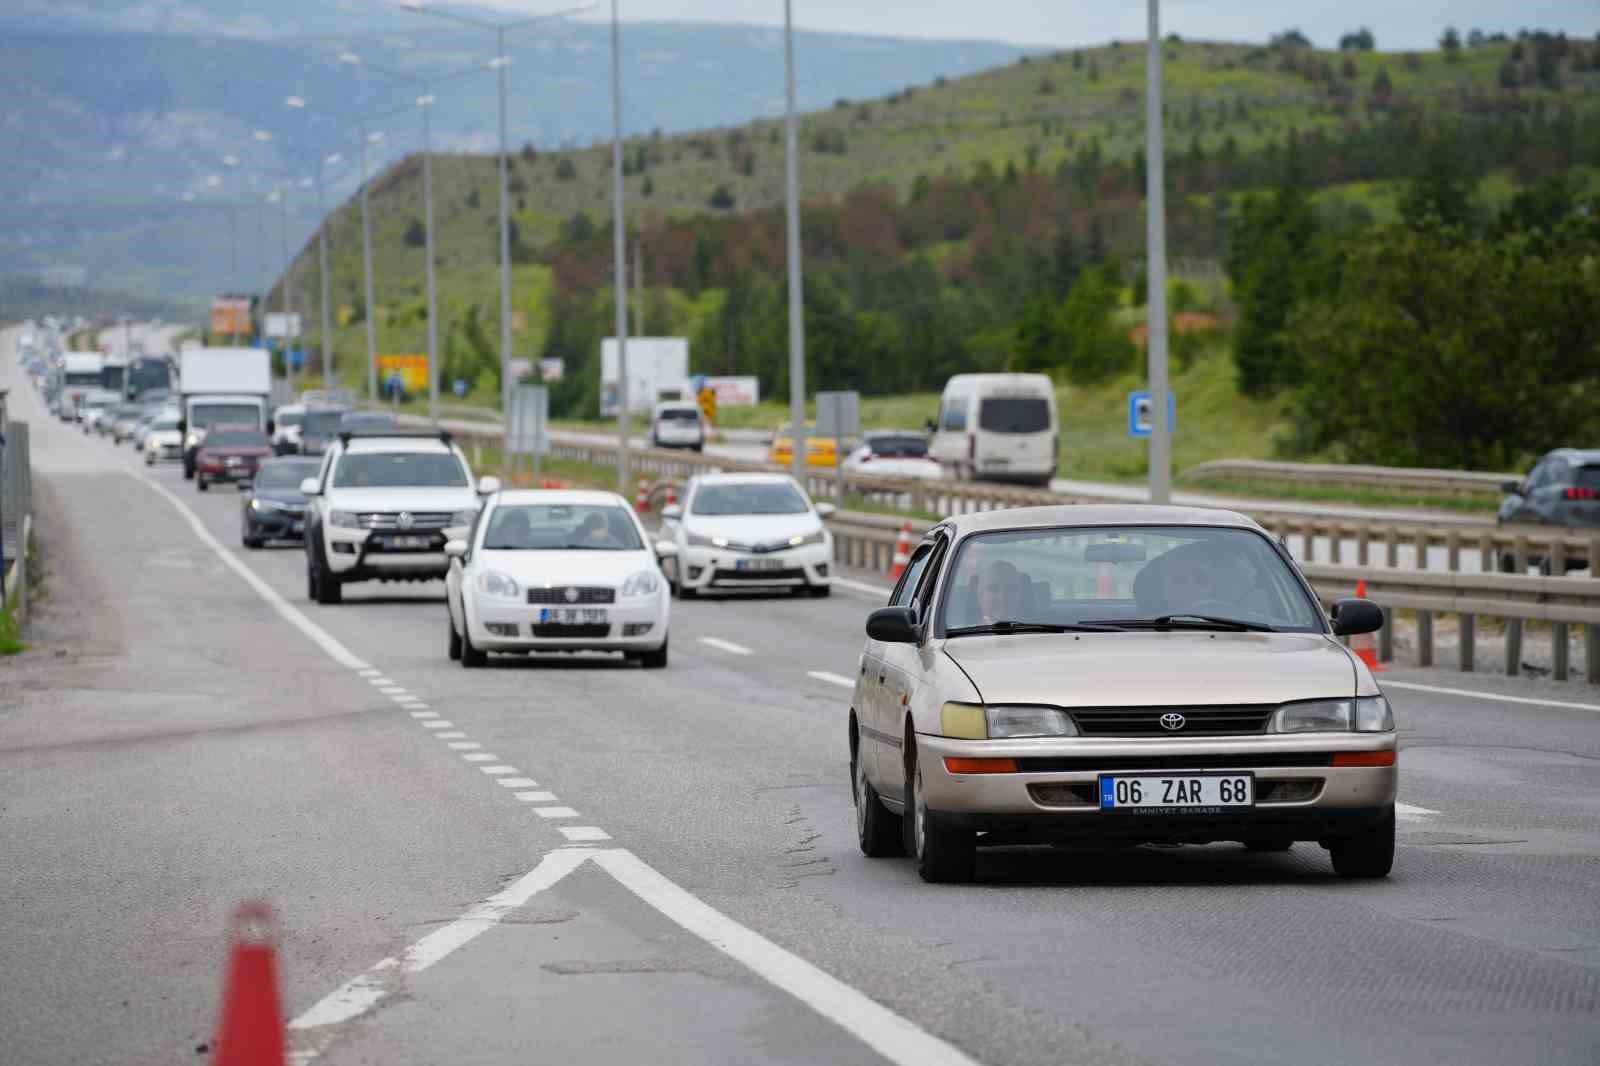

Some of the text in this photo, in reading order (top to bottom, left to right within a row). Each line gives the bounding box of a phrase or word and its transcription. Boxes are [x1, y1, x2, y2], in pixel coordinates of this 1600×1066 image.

[1116, 778, 1247, 804] 06 ZAR 68
